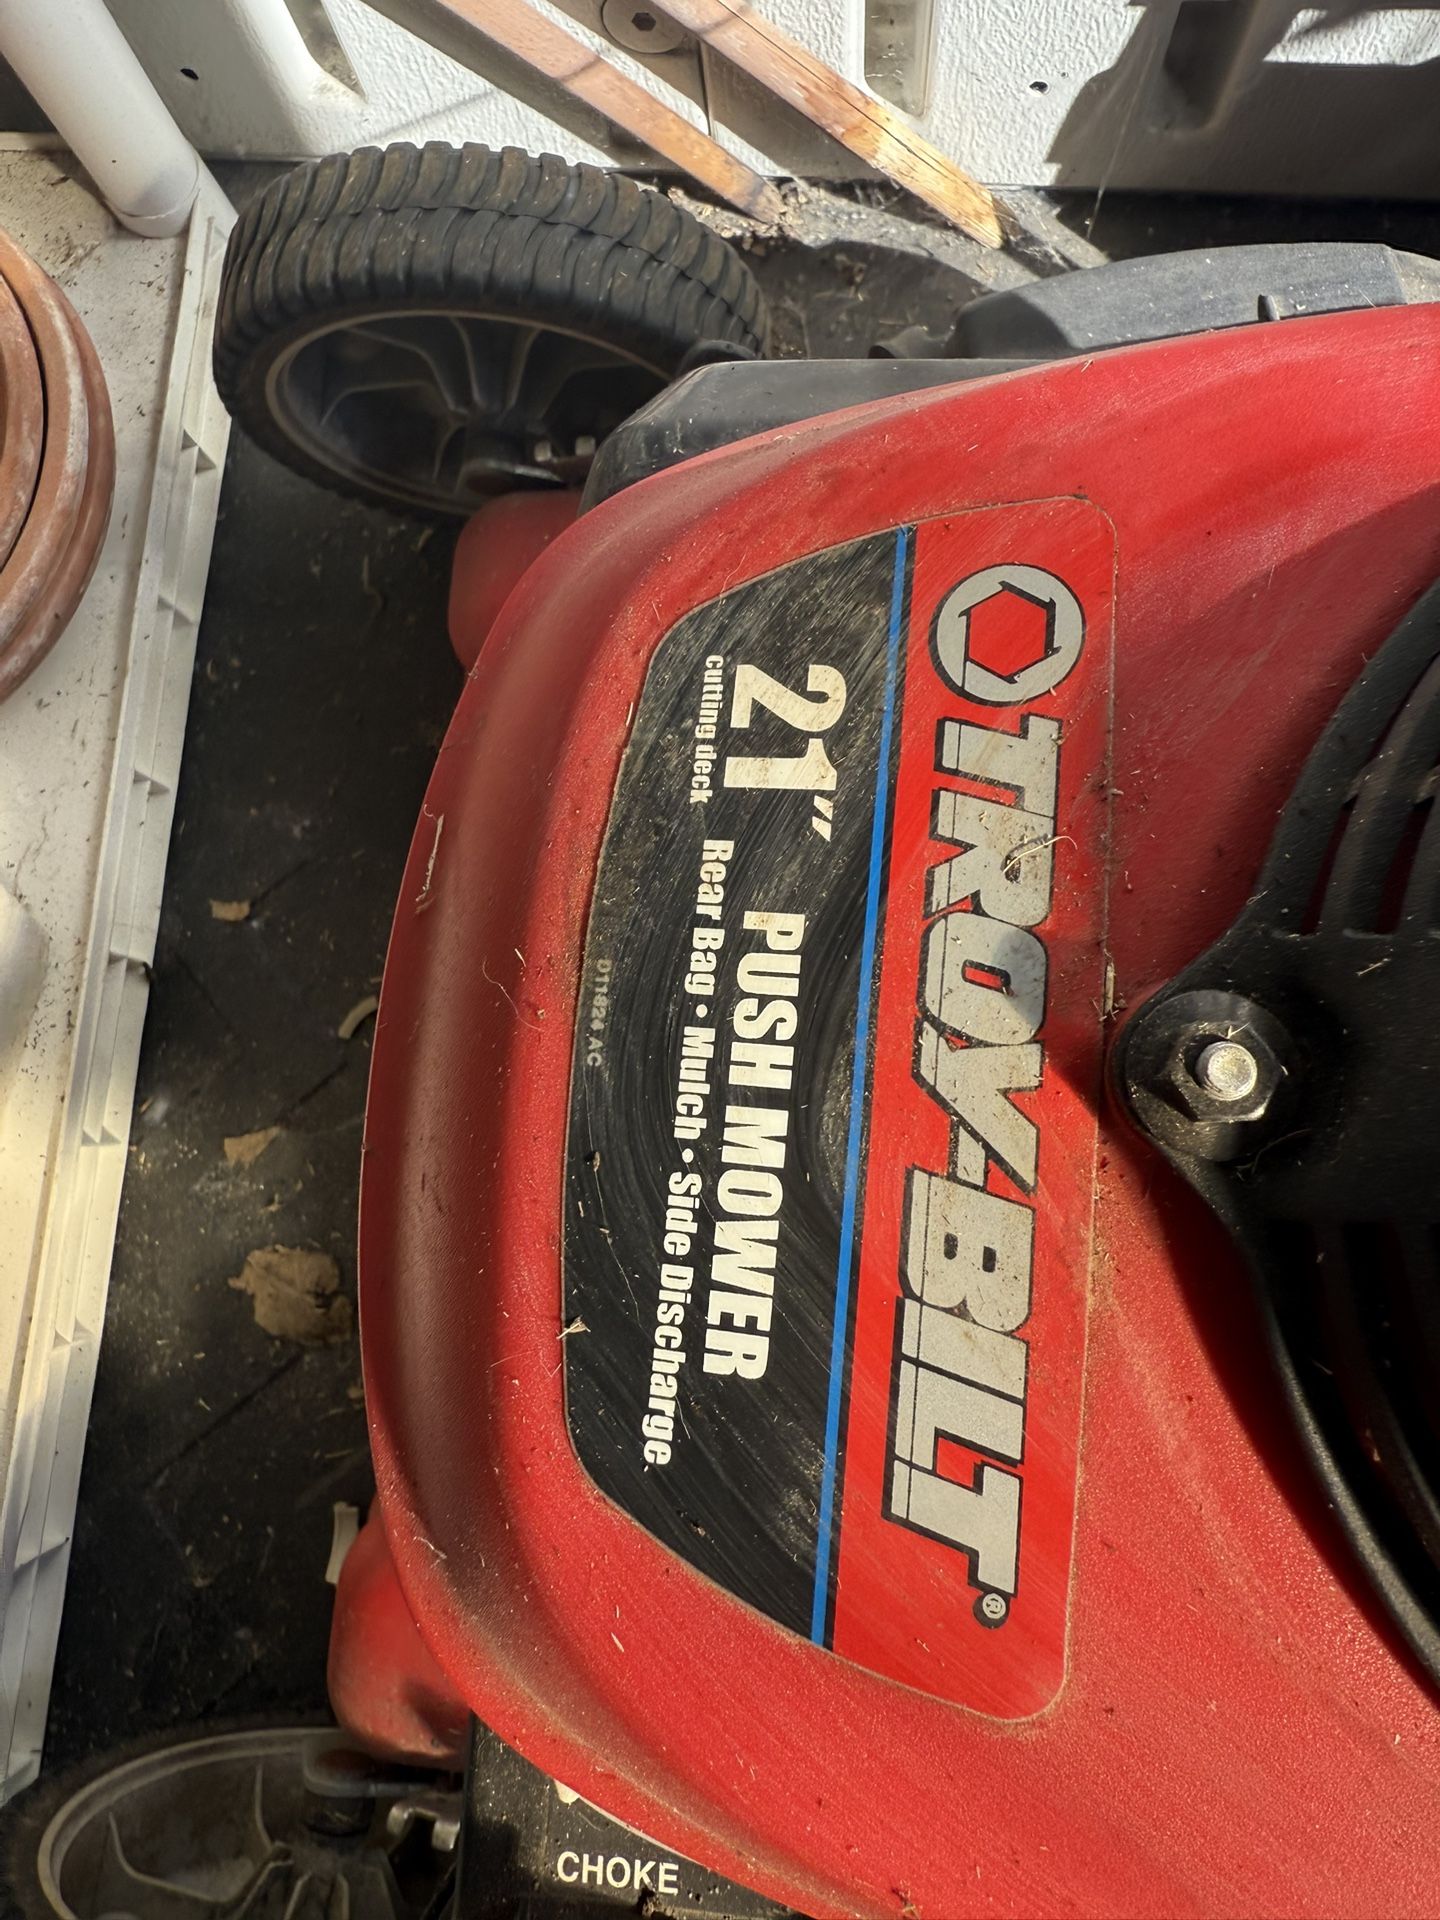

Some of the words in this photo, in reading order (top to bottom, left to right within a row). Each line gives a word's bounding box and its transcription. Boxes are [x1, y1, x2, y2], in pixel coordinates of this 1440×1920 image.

[695, 654, 724, 739] cutting
[690, 740, 718, 805] deck
[697, 839, 734, 921] Rear
[684, 927, 725, 997] Bag
[728, 910, 806, 1090] PUSH
[586, 1036, 604, 1067] AC
[673, 1026, 717, 1141] Mulch
[662, 1171, 703, 1257] Side
[702, 1106, 790, 1380] MOWER
[642, 1264, 694, 1466] Discharge
[555, 1851, 680, 1895] CHOKE
